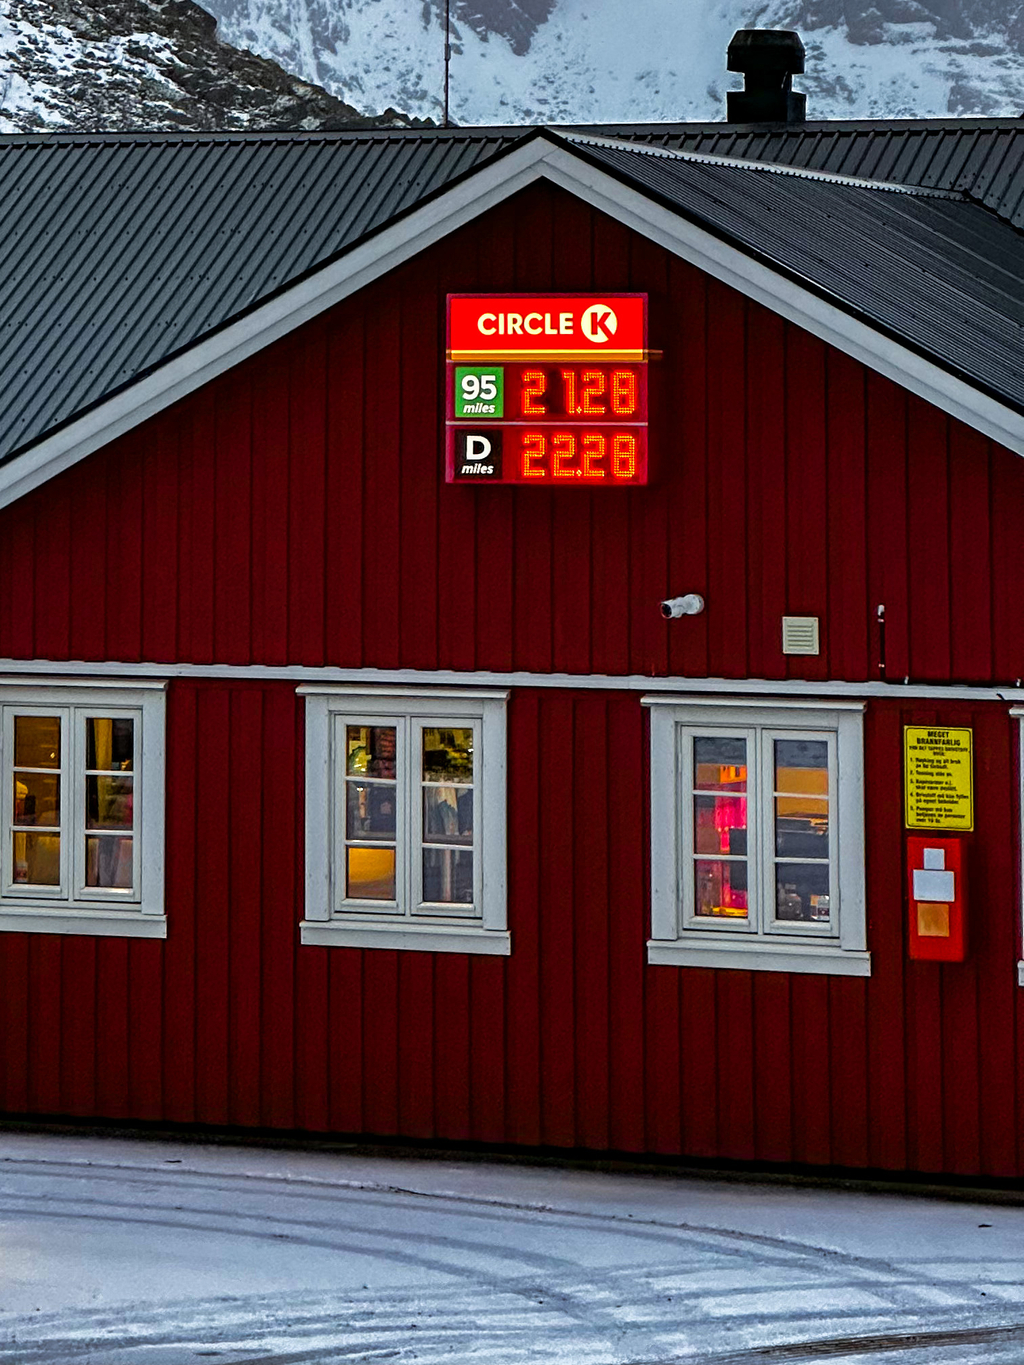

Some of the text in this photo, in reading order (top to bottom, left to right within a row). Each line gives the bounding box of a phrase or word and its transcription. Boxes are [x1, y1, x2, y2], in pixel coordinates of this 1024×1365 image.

[477, 304, 618, 343] CIRCLE K
[461, 374, 497, 401] 95
[463, 402, 496, 414] miles
[466, 435, 492, 461] D
[523, 434, 636, 478] 22.28
[461, 463, 494, 475] miles
[917, 737, 961, 746] BRANNFARLIG
[927, 730, 949, 738] MEGET
